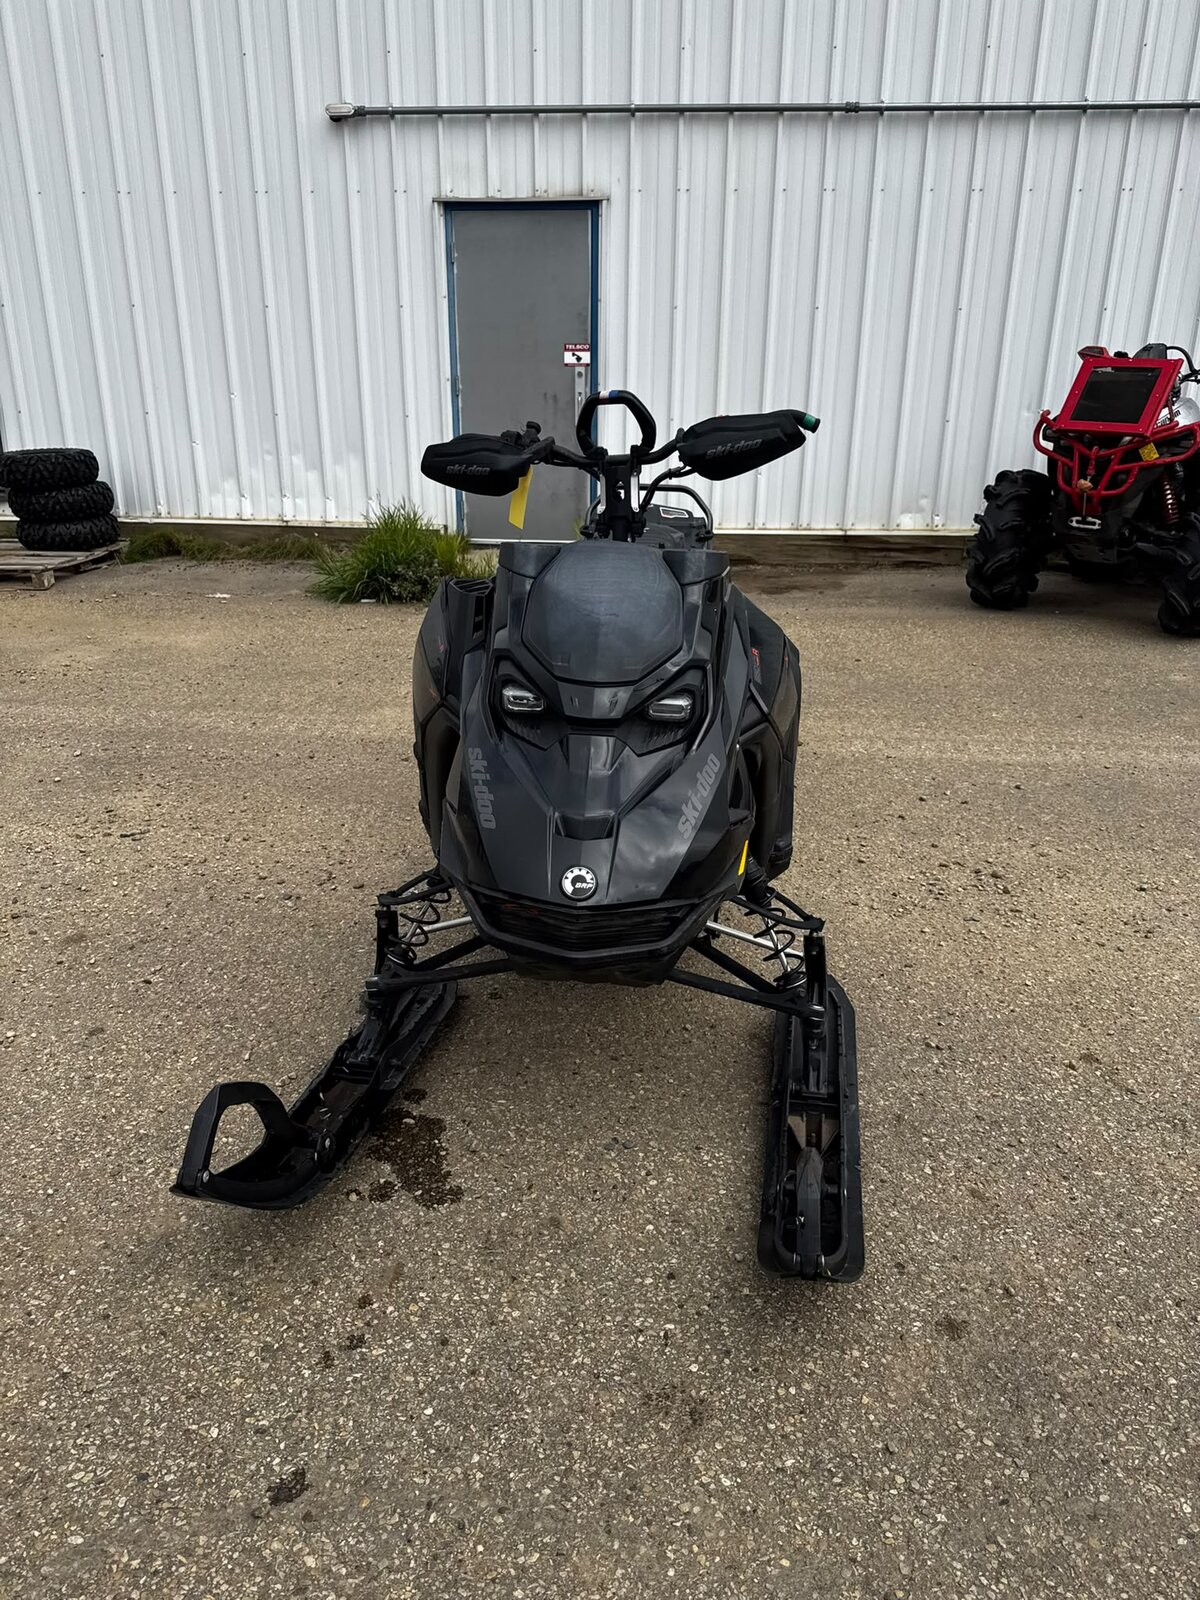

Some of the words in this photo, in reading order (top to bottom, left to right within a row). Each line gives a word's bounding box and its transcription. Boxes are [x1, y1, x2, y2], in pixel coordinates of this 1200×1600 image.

[446, 464, 490, 475] ski-doo
[705, 439, 762, 459] ski-doo
[468, 747, 497, 830] ski-doo
[678, 753, 721, 840] ski-doo
